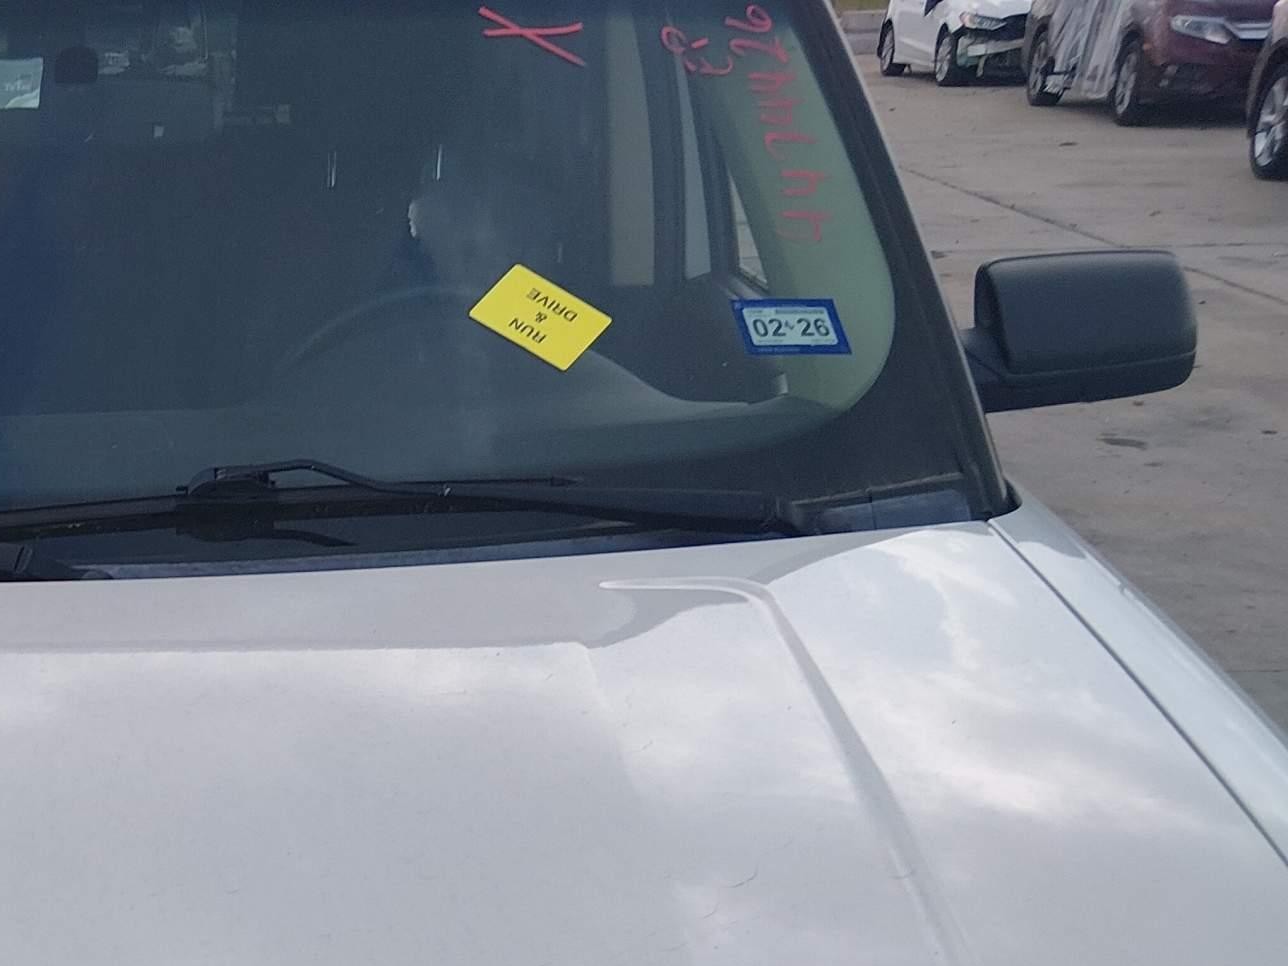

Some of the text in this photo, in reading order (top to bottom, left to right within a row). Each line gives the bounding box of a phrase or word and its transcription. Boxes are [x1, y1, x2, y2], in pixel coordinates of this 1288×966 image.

[526, 287, 578, 322] DRIVE
[535, 311, 548, 324] &
[752, 318, 830, 337] 02 26
[508, 317, 546, 344] RUN
